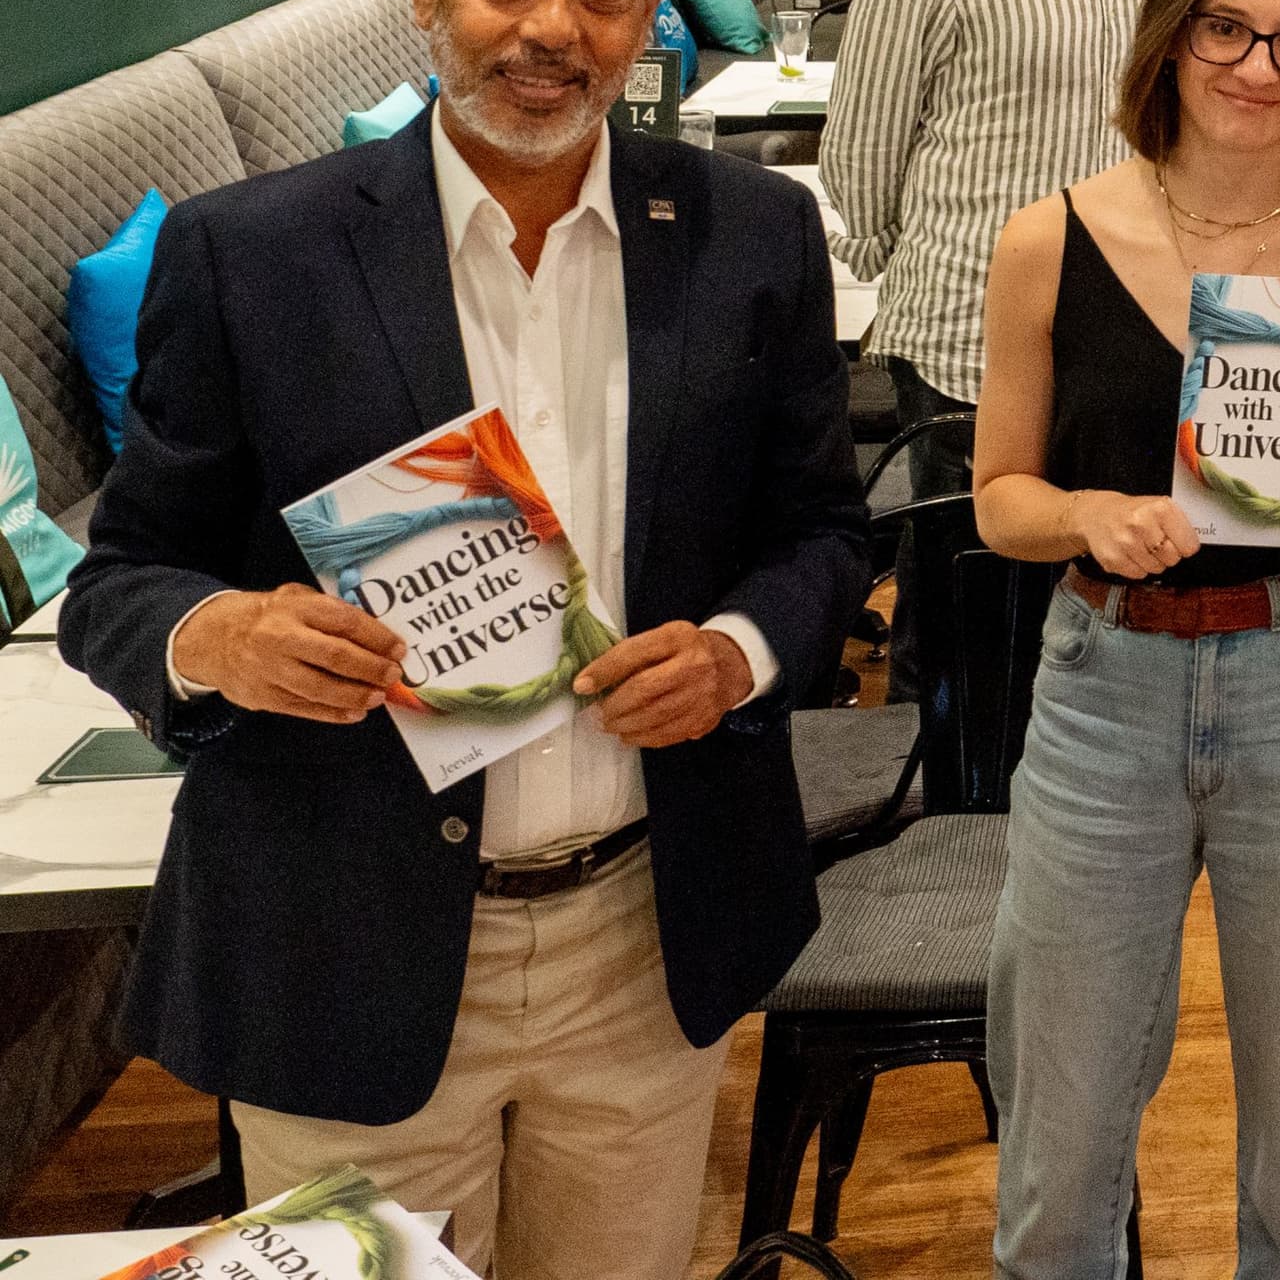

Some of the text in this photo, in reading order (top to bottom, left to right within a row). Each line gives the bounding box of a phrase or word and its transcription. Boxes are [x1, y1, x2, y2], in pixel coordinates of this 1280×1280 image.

[629, 106, 657, 125] 14
[1224, 397, 1273, 421] with
[1196, 522, 1217, 536] vak
[354, 515, 541, 619] Dancing
[408, 563, 523, 636] with the
[400, 580, 571, 688] Universe
[437, 745, 485, 782] Jeevak
